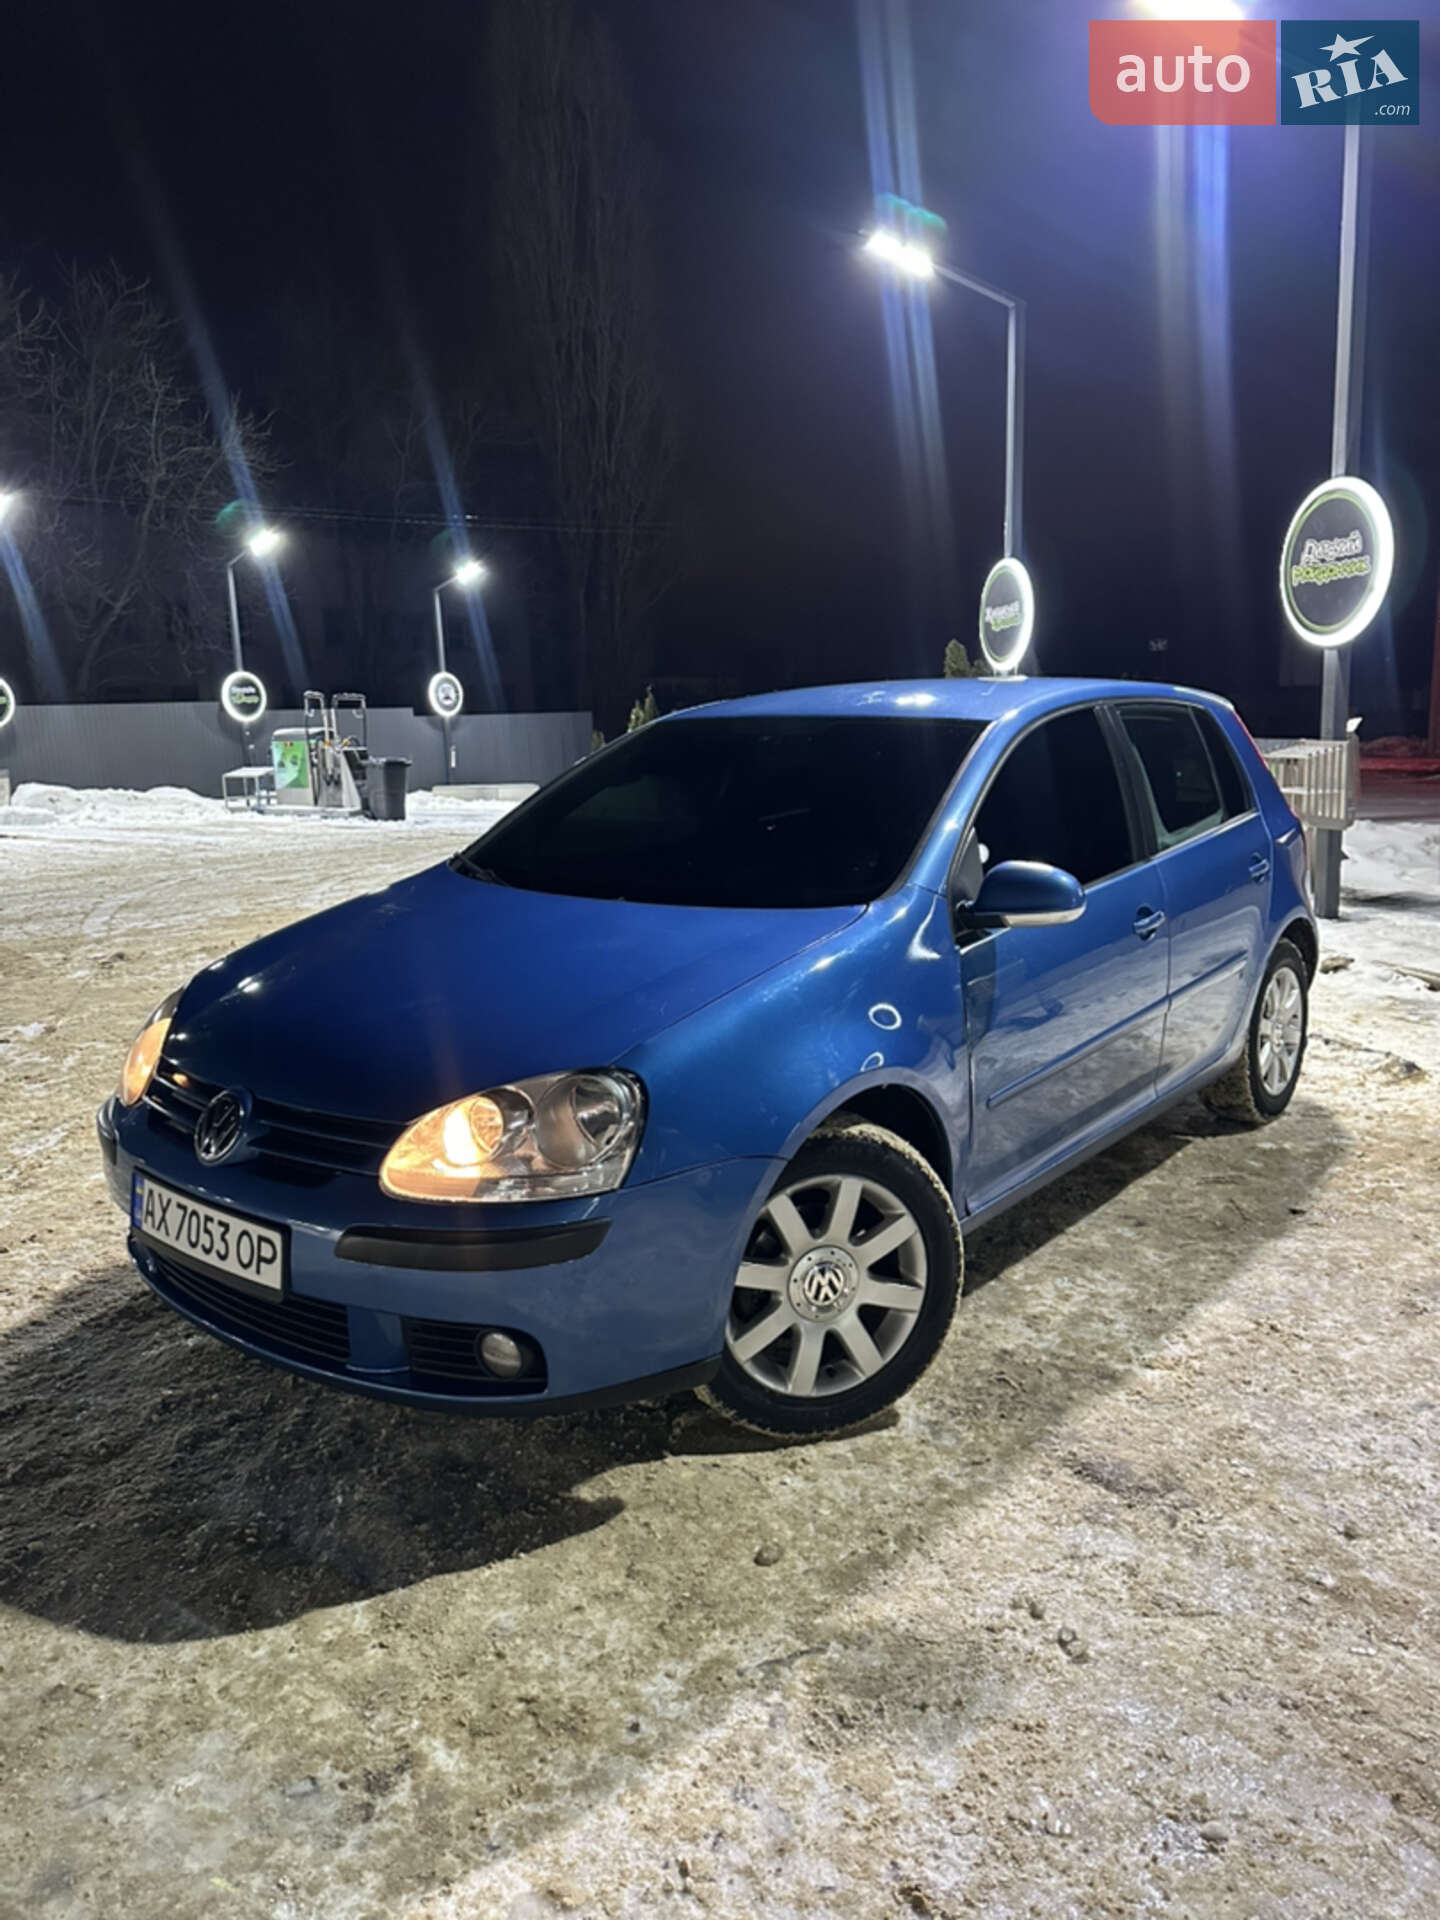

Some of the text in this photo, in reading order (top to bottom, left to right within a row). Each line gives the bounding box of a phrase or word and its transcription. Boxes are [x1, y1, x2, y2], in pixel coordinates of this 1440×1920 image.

[144, 1189, 278, 1276] AX 7053 OP
